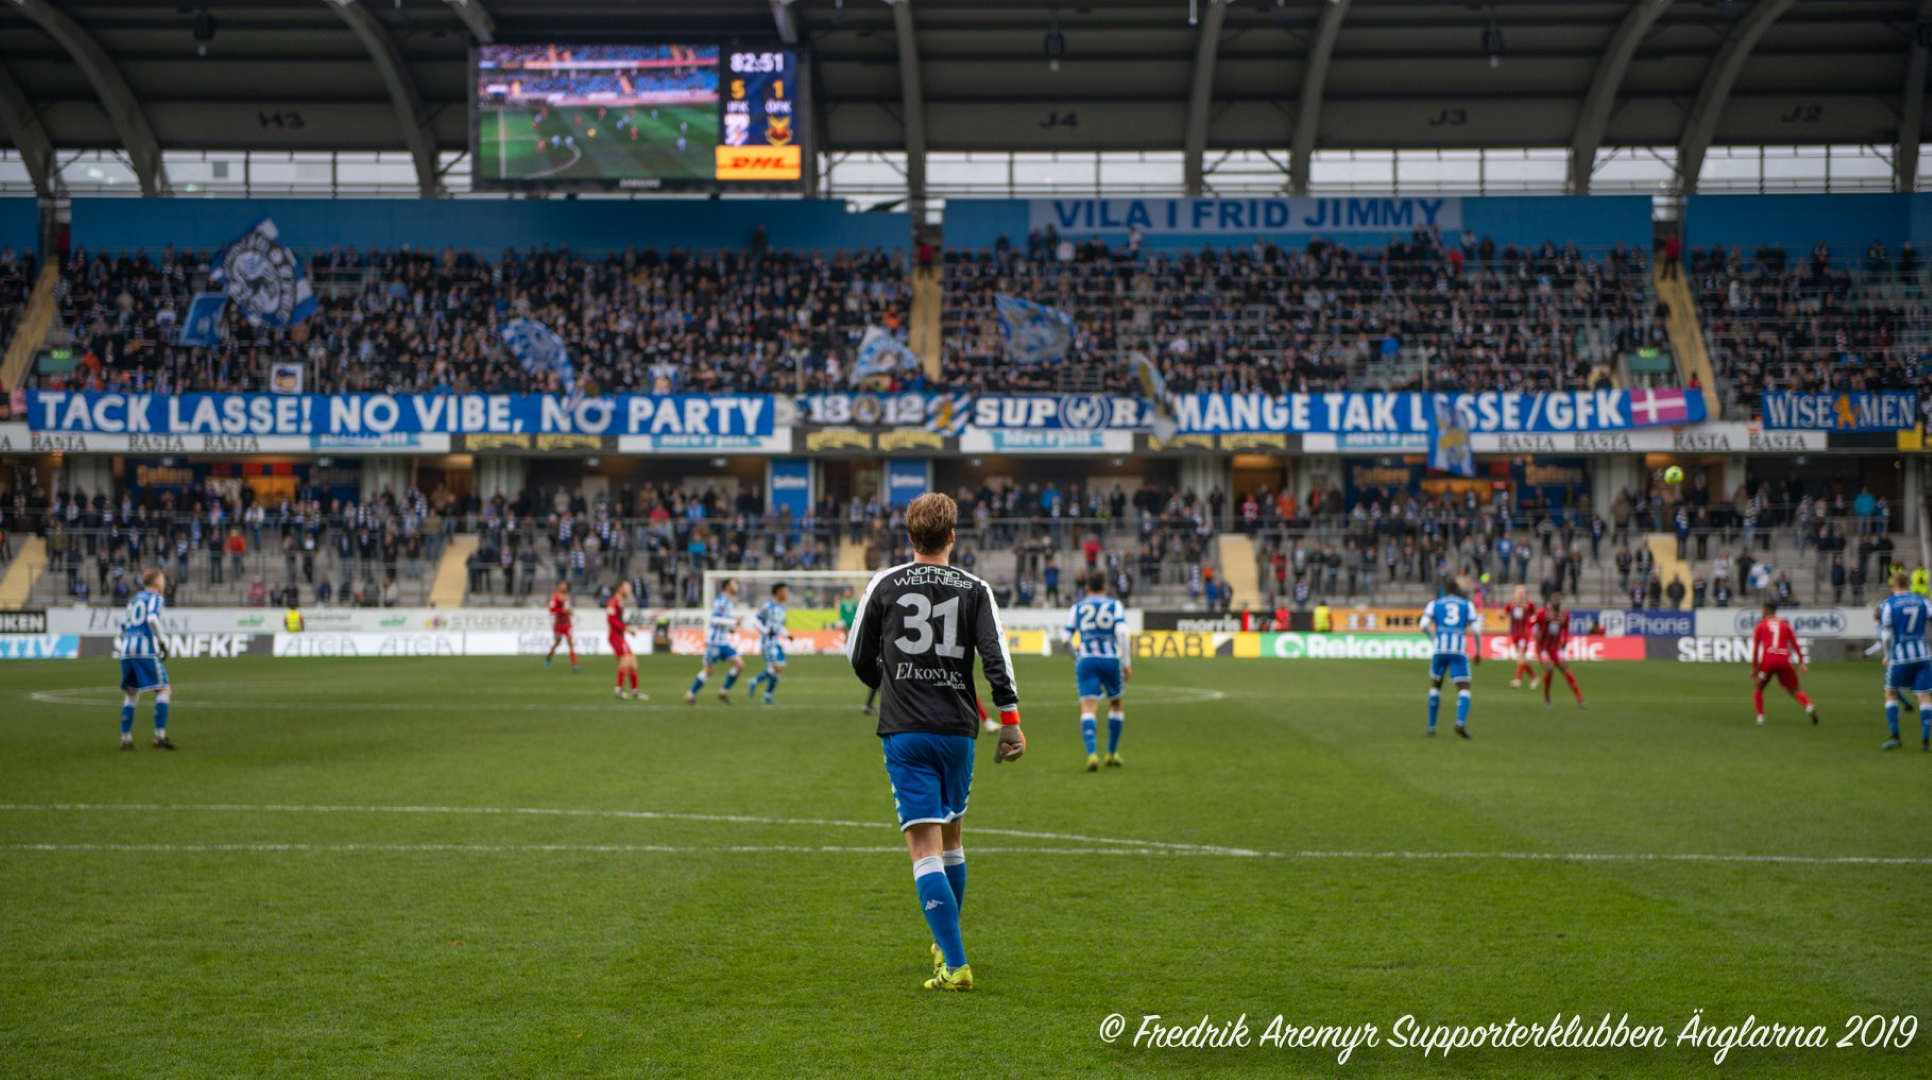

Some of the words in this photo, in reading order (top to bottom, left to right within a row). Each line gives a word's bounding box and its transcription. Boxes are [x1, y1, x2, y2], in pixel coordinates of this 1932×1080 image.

[731, 53, 784, 72] 82:51
[731, 80, 745, 99] 5
[773, 80, 783, 98] 1
[1039, 112, 1078, 128] J4
[1429, 109, 1467, 126] J3
[1781, 105, 1823, 122] J2
[731, 157, 785, 168] DHL
[1053, 201, 1151, 228] VILA
[1167, 201, 1177, 228] I
[1194, 201, 1289, 228] FRID
[1304, 200, 1445, 227] JIMMY
[38, 392, 151, 432] TACK
[169, 396, 312, 433] LASSE!
[330, 395, 400, 433] NO
[412, 395, 524, 434] VIBE,
[541, 396, 612, 434] NO
[628, 397, 764, 434] PARTY
[808, 394, 850, 423] 13
[884, 394, 924, 423] 12
[1174, 393, 1310, 431] MANGE
[1324, 393, 1399, 431] TAK
[1410, 390, 1625, 431] LSSE/GFK
[1766, 395, 1834, 427] WISE
[1859, 394, 1917, 427] MEN
[31, 433, 87, 451] RASTA
[129, 433, 186, 451] RASTA
[203, 433, 260, 451] RASTA
[1673, 432, 1731, 451] RASTA
[1749, 432, 1807, 451] RASTA
[894, 575, 973, 589] WELLNESS
[907, 566, 960, 580] NORDIC
[1080, 603, 1115, 632] 26
[1177, 613, 1241, 632] morris
[1444, 602, 1461, 626] 3
[1903, 605, 1920, 634] 7
[894, 592, 966, 659] 31
[1626, 616, 1691, 635] Phone
[1307, 631, 1435, 659] Rekomo
